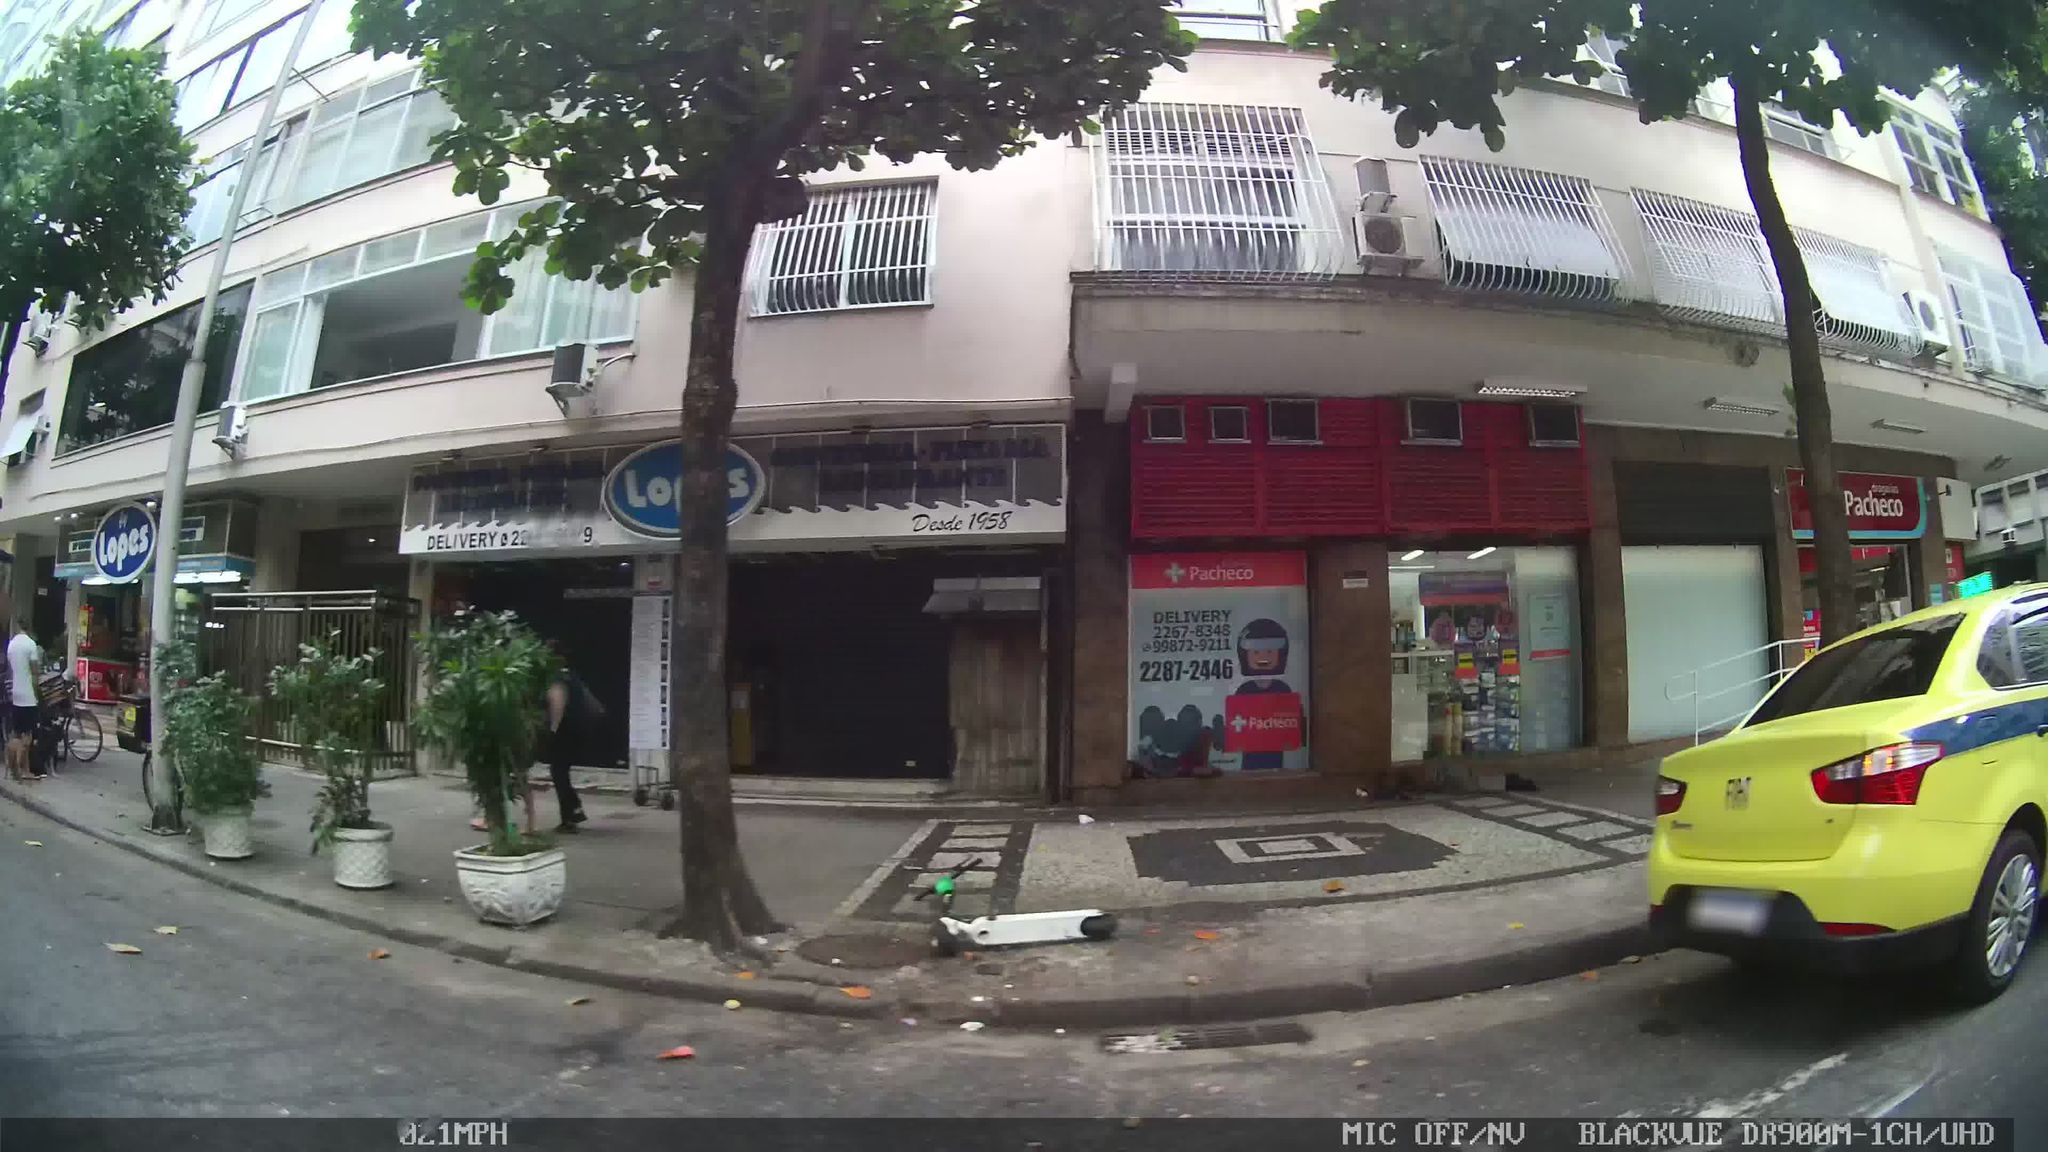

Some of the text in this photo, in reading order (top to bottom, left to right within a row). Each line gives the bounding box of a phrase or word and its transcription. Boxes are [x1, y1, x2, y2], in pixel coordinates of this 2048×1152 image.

[624, 467, 750, 512] Los
[1844, 489, 1904, 517] Pacheco
[912, 511, 1013, 532] Desde 1958
[100, 524, 149, 572] Lopes
[427, 530, 498, 550] DELIVERY
[1189, 565, 1254, 581] Pacheco
[1153, 610, 1232, 624] DELIVERY
[1140, 659, 1233, 682] 2287-2446
